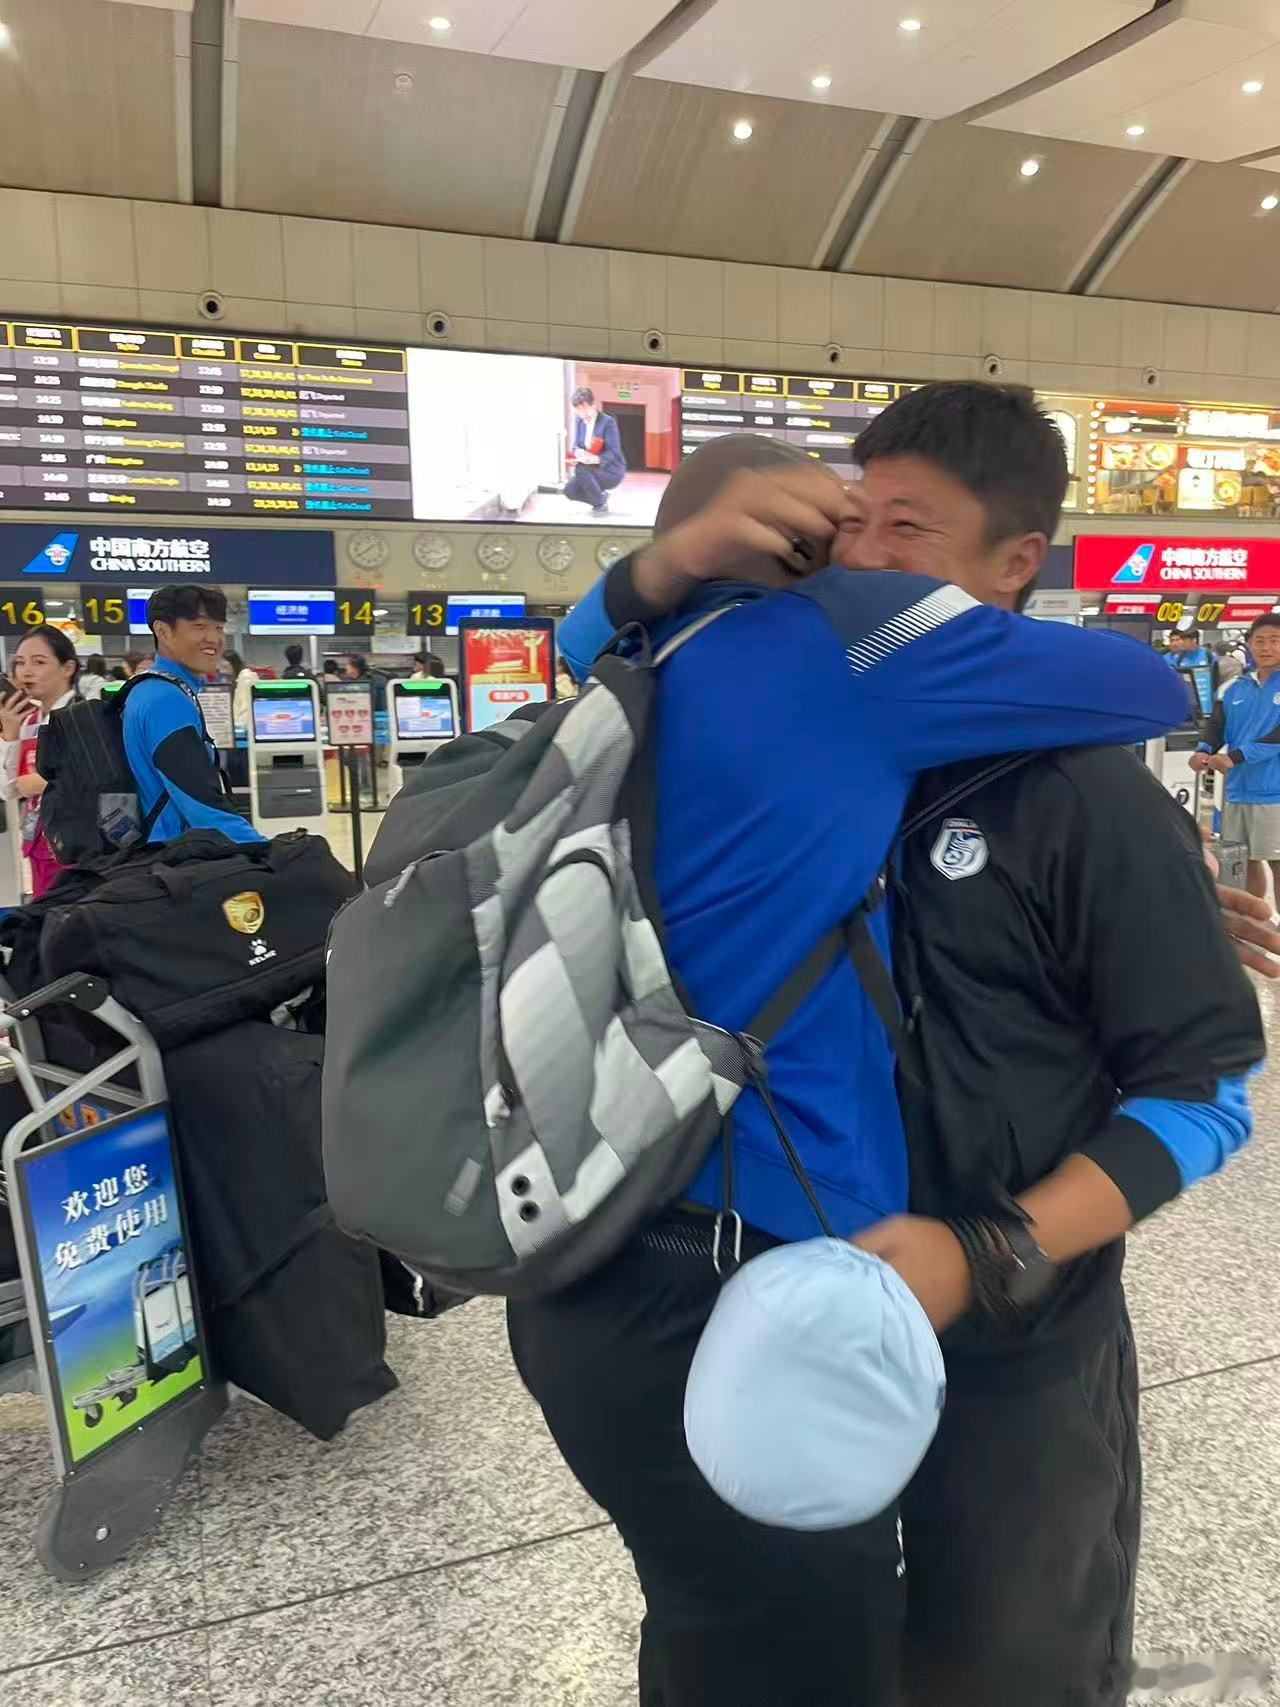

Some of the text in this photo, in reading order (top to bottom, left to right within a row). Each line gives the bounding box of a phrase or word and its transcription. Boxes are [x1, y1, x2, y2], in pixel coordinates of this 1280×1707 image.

[90, 537, 210, 559] 中国南方航空
[90, 558, 210, 572] CHINA SOUTHERN
[1160, 567, 1247, 580] CHINA SOUTHERN
[2, 602, 44, 625] 16
[86, 598, 124, 624] 15
[340, 602, 372, 625] 14
[412, 604, 443, 626] 13
[1197, 603, 1225, 622] 07
[62, 1163, 151, 1224] 欢迎您
[54, 1194, 169, 1272] 免费使用
